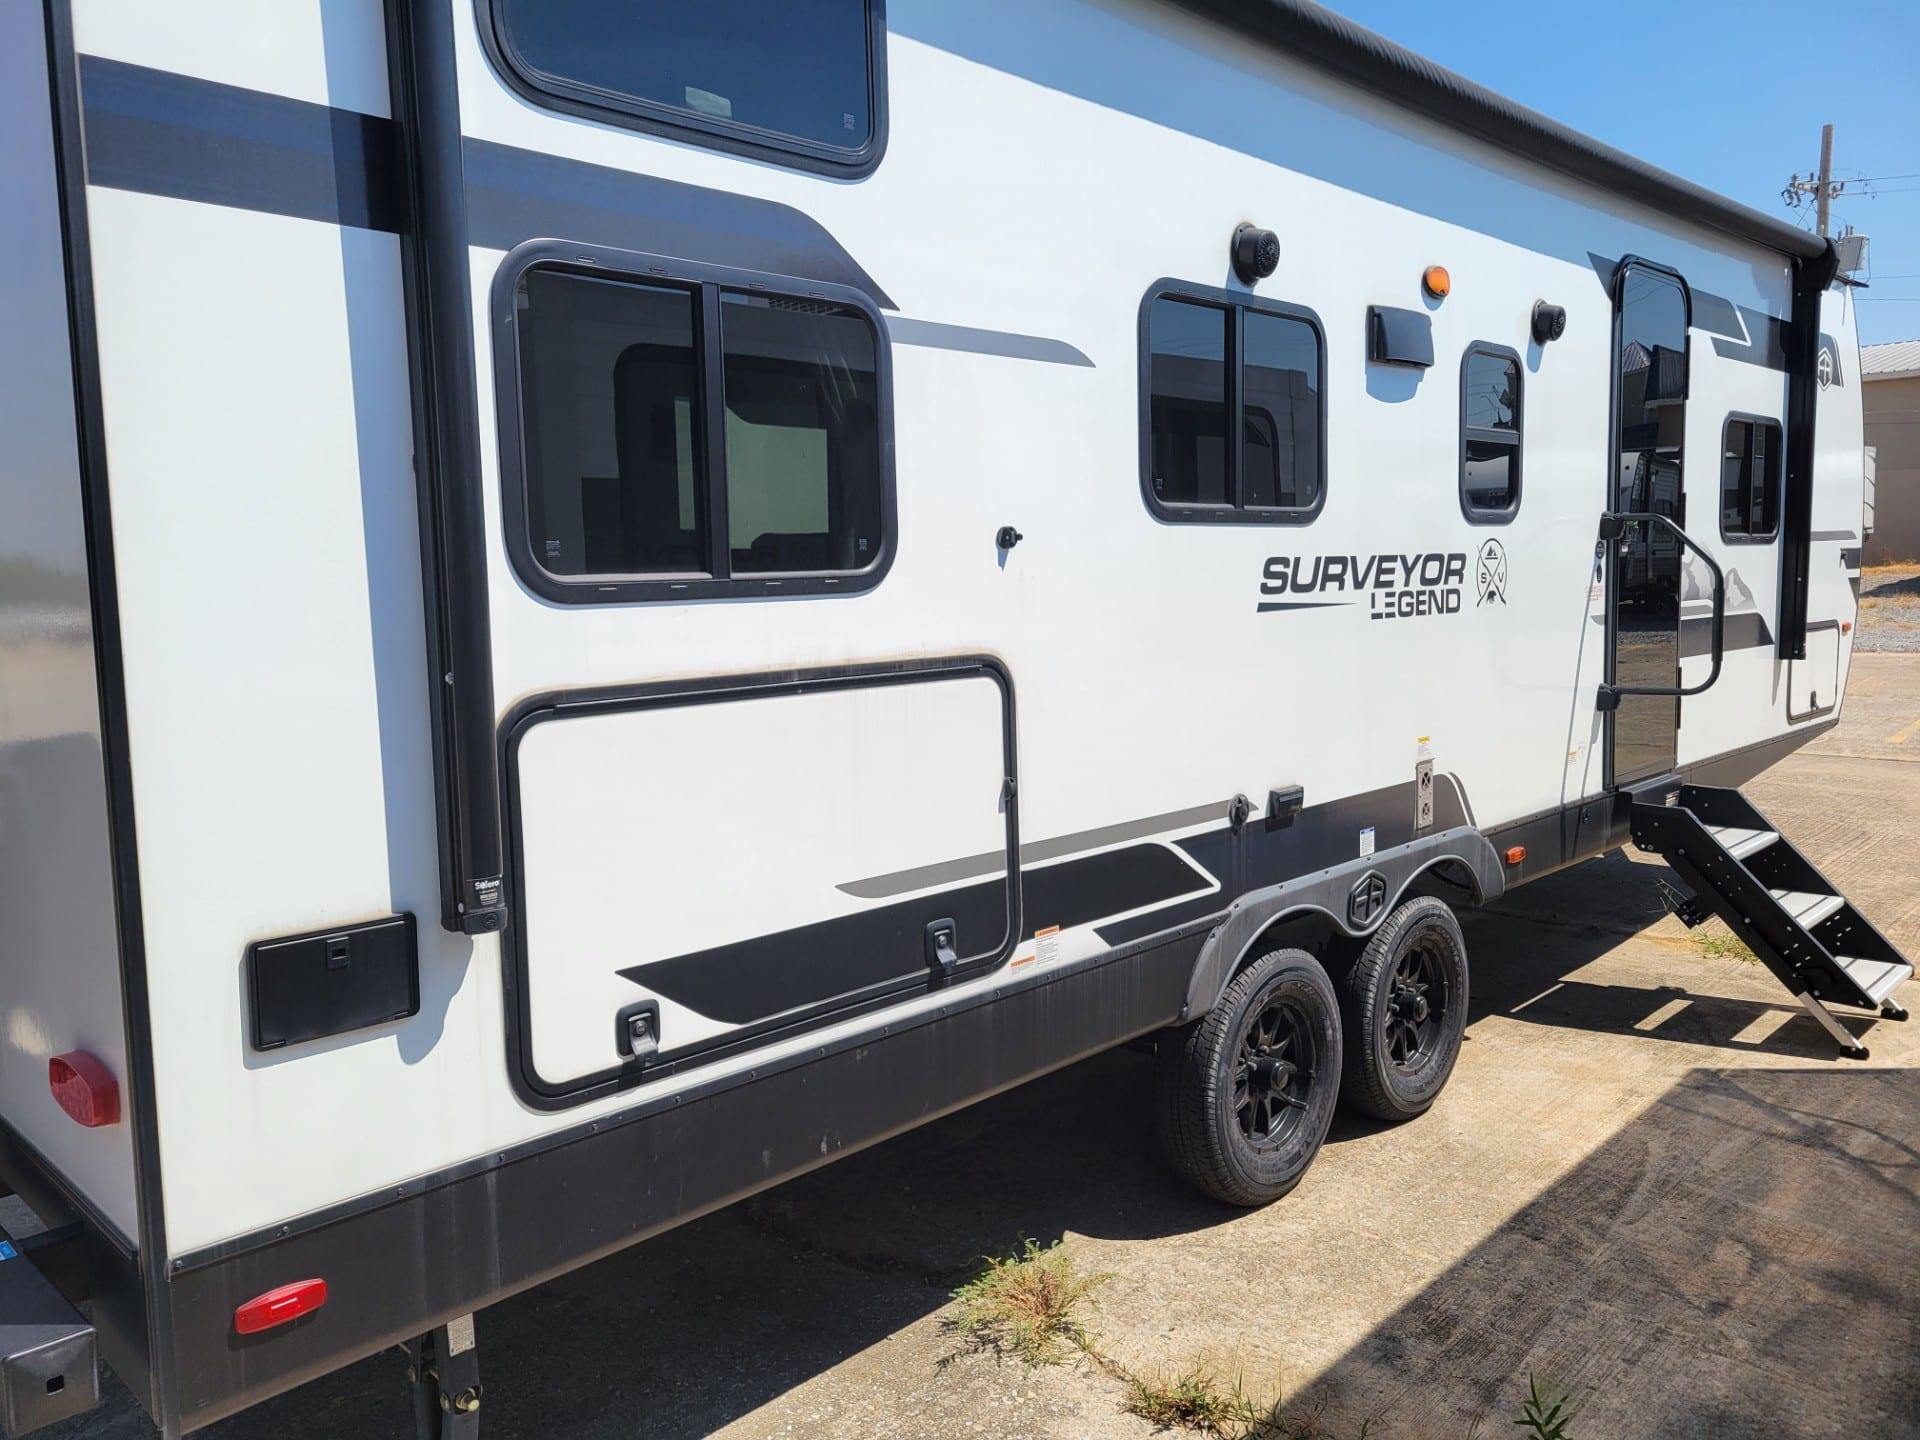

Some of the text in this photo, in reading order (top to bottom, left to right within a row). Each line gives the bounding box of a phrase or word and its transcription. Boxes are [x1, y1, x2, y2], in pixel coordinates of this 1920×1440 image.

[1260, 553, 1467, 595] SURVEYOR
[1370, 588, 1461, 620] LEGEND
[474, 880, 500, 890] Solera
